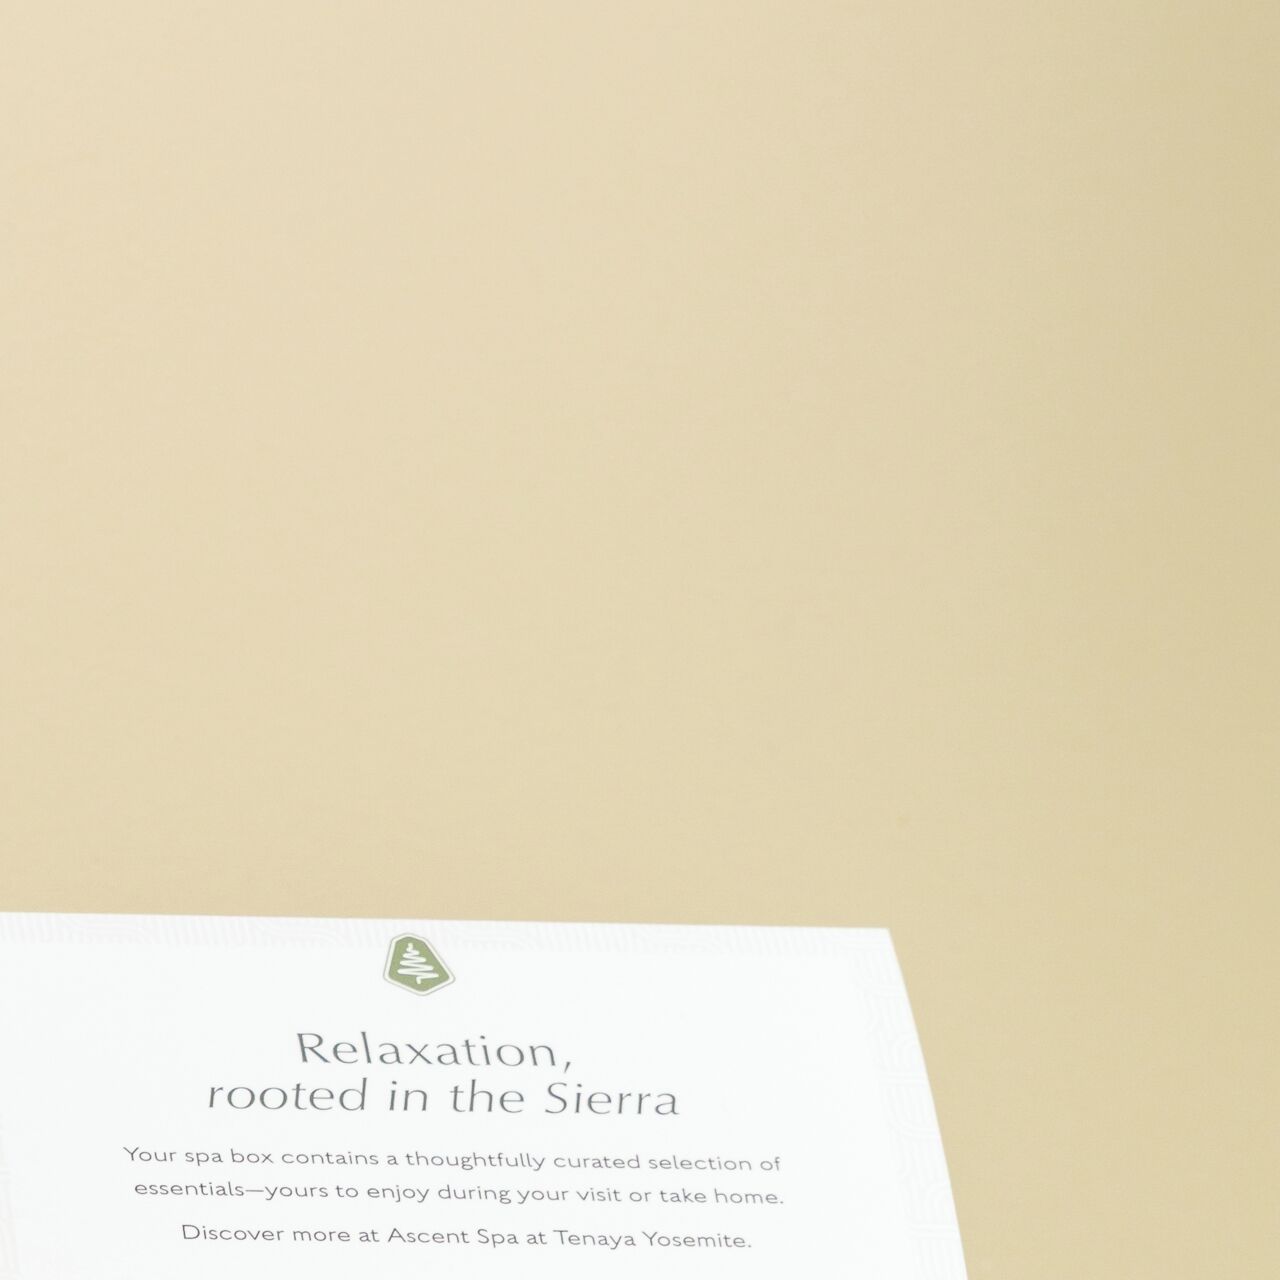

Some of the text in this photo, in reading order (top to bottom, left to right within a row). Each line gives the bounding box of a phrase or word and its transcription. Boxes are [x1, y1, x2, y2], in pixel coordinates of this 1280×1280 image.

[296, 1031, 571, 1073] Relaxation,
[208, 1076, 679, 1116] rooted in the Sierra
[122, 1146, 780, 1172] Your spa box contains a thoughtfully curated selection of
[335, 1184, 359, 1199] to
[366, 1184, 430, 1204] enjoy
[437, 1184, 512, 1205] during
[516, 1189, 569, 1205] your
[575, 1187, 622, 1202] visit
[629, 1191, 652, 1203] or
[659, 1187, 707, 1204] take
[713, 1187, 784, 1205] home.
[181, 1224, 752, 1251] Discover more at Ascent Spa at Tenaya Yosemite.
